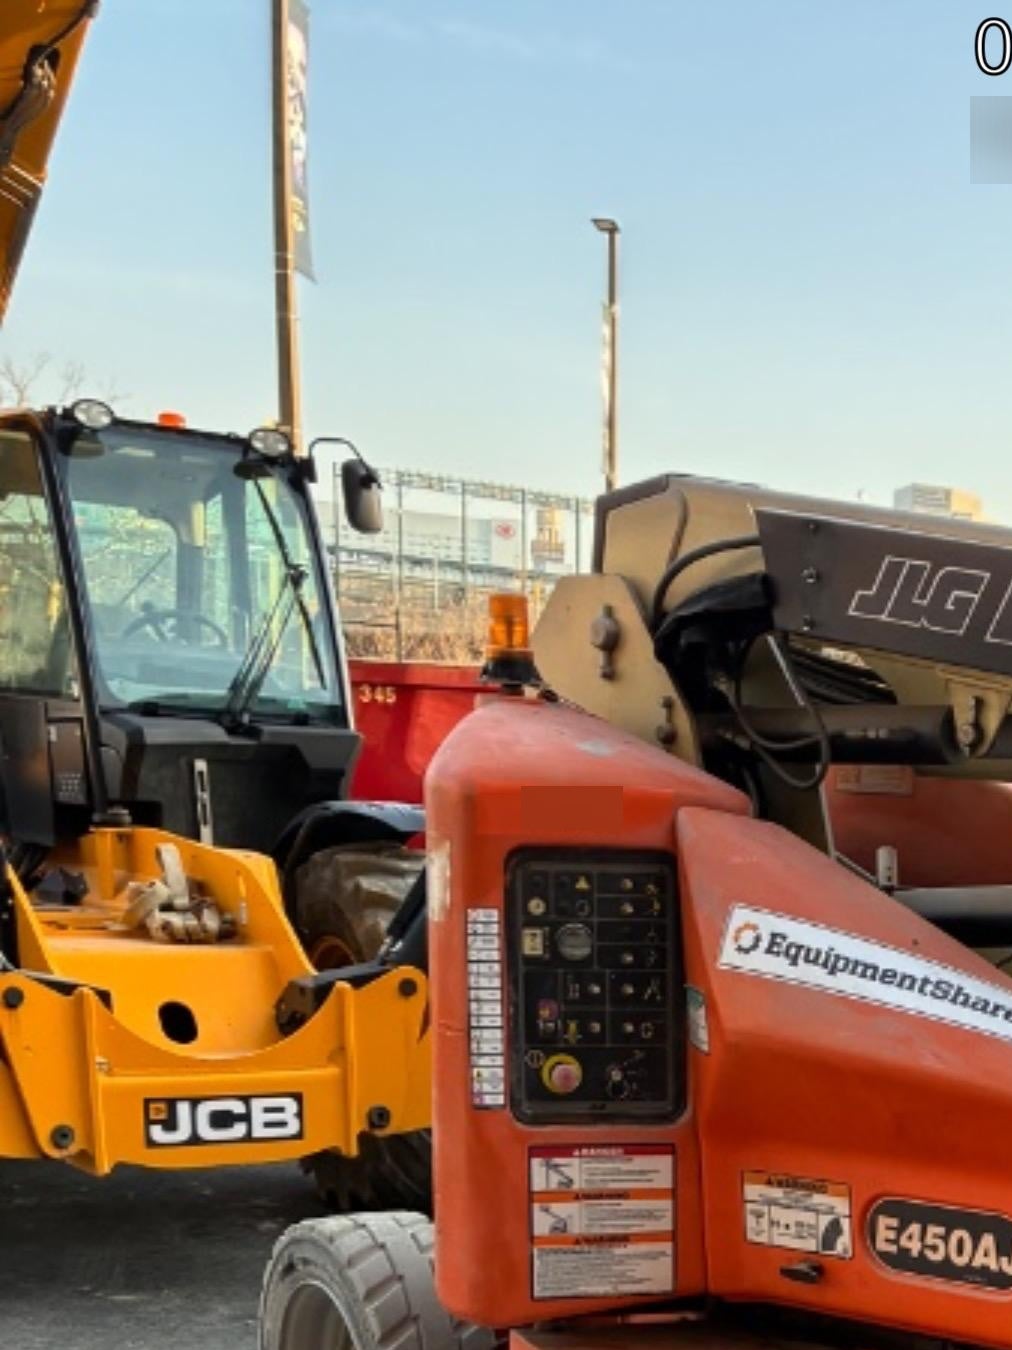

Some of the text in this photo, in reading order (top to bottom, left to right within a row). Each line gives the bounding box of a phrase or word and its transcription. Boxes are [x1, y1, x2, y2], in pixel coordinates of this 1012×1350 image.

[847, 555, 991, 636] JLG
[358, 684, 397, 704] 345
[148, 1096, 301, 1144] JCB
